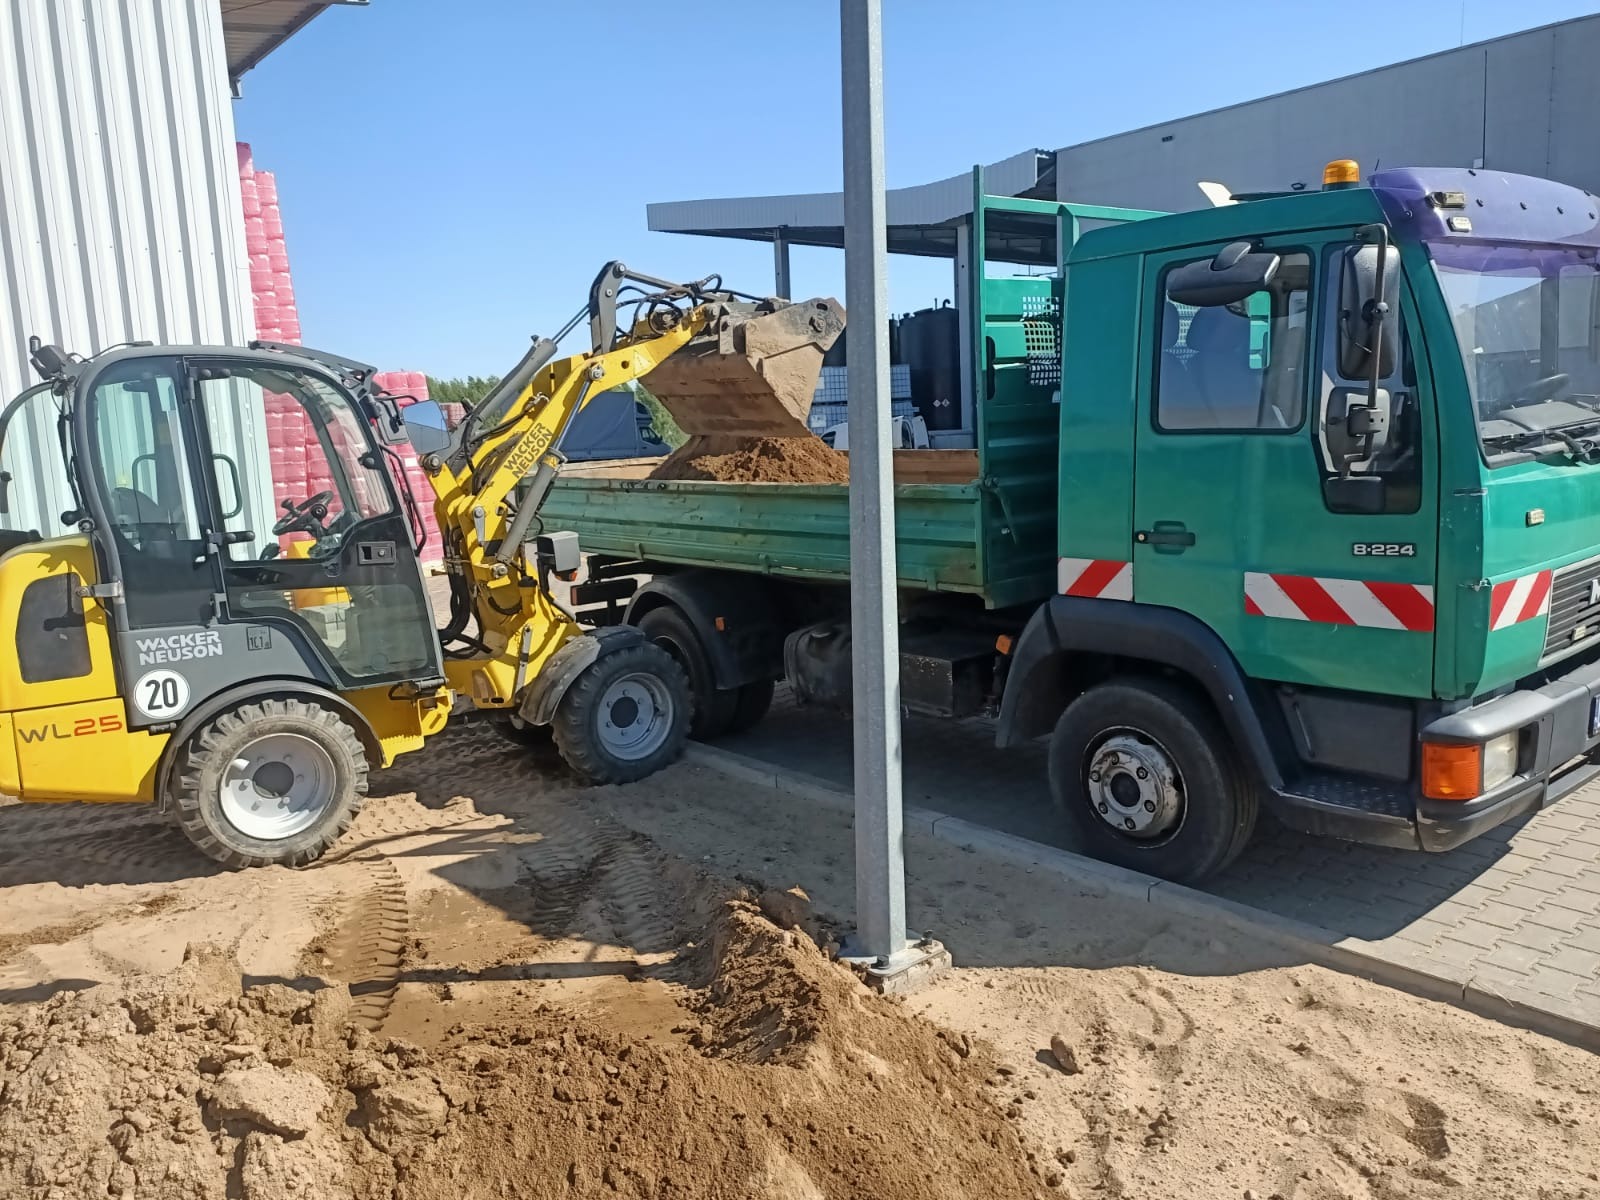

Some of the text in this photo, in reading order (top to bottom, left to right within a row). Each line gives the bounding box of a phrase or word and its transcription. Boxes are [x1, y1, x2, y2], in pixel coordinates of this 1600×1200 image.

[504, 422, 546, 470] WACKER
[512, 428, 553, 479] NEUSON
[136, 630, 221, 652] WACKER
[139, 643, 223, 666] NEUSON
[145, 677, 179, 711] 20
[18, 714, 123, 743] WL25
